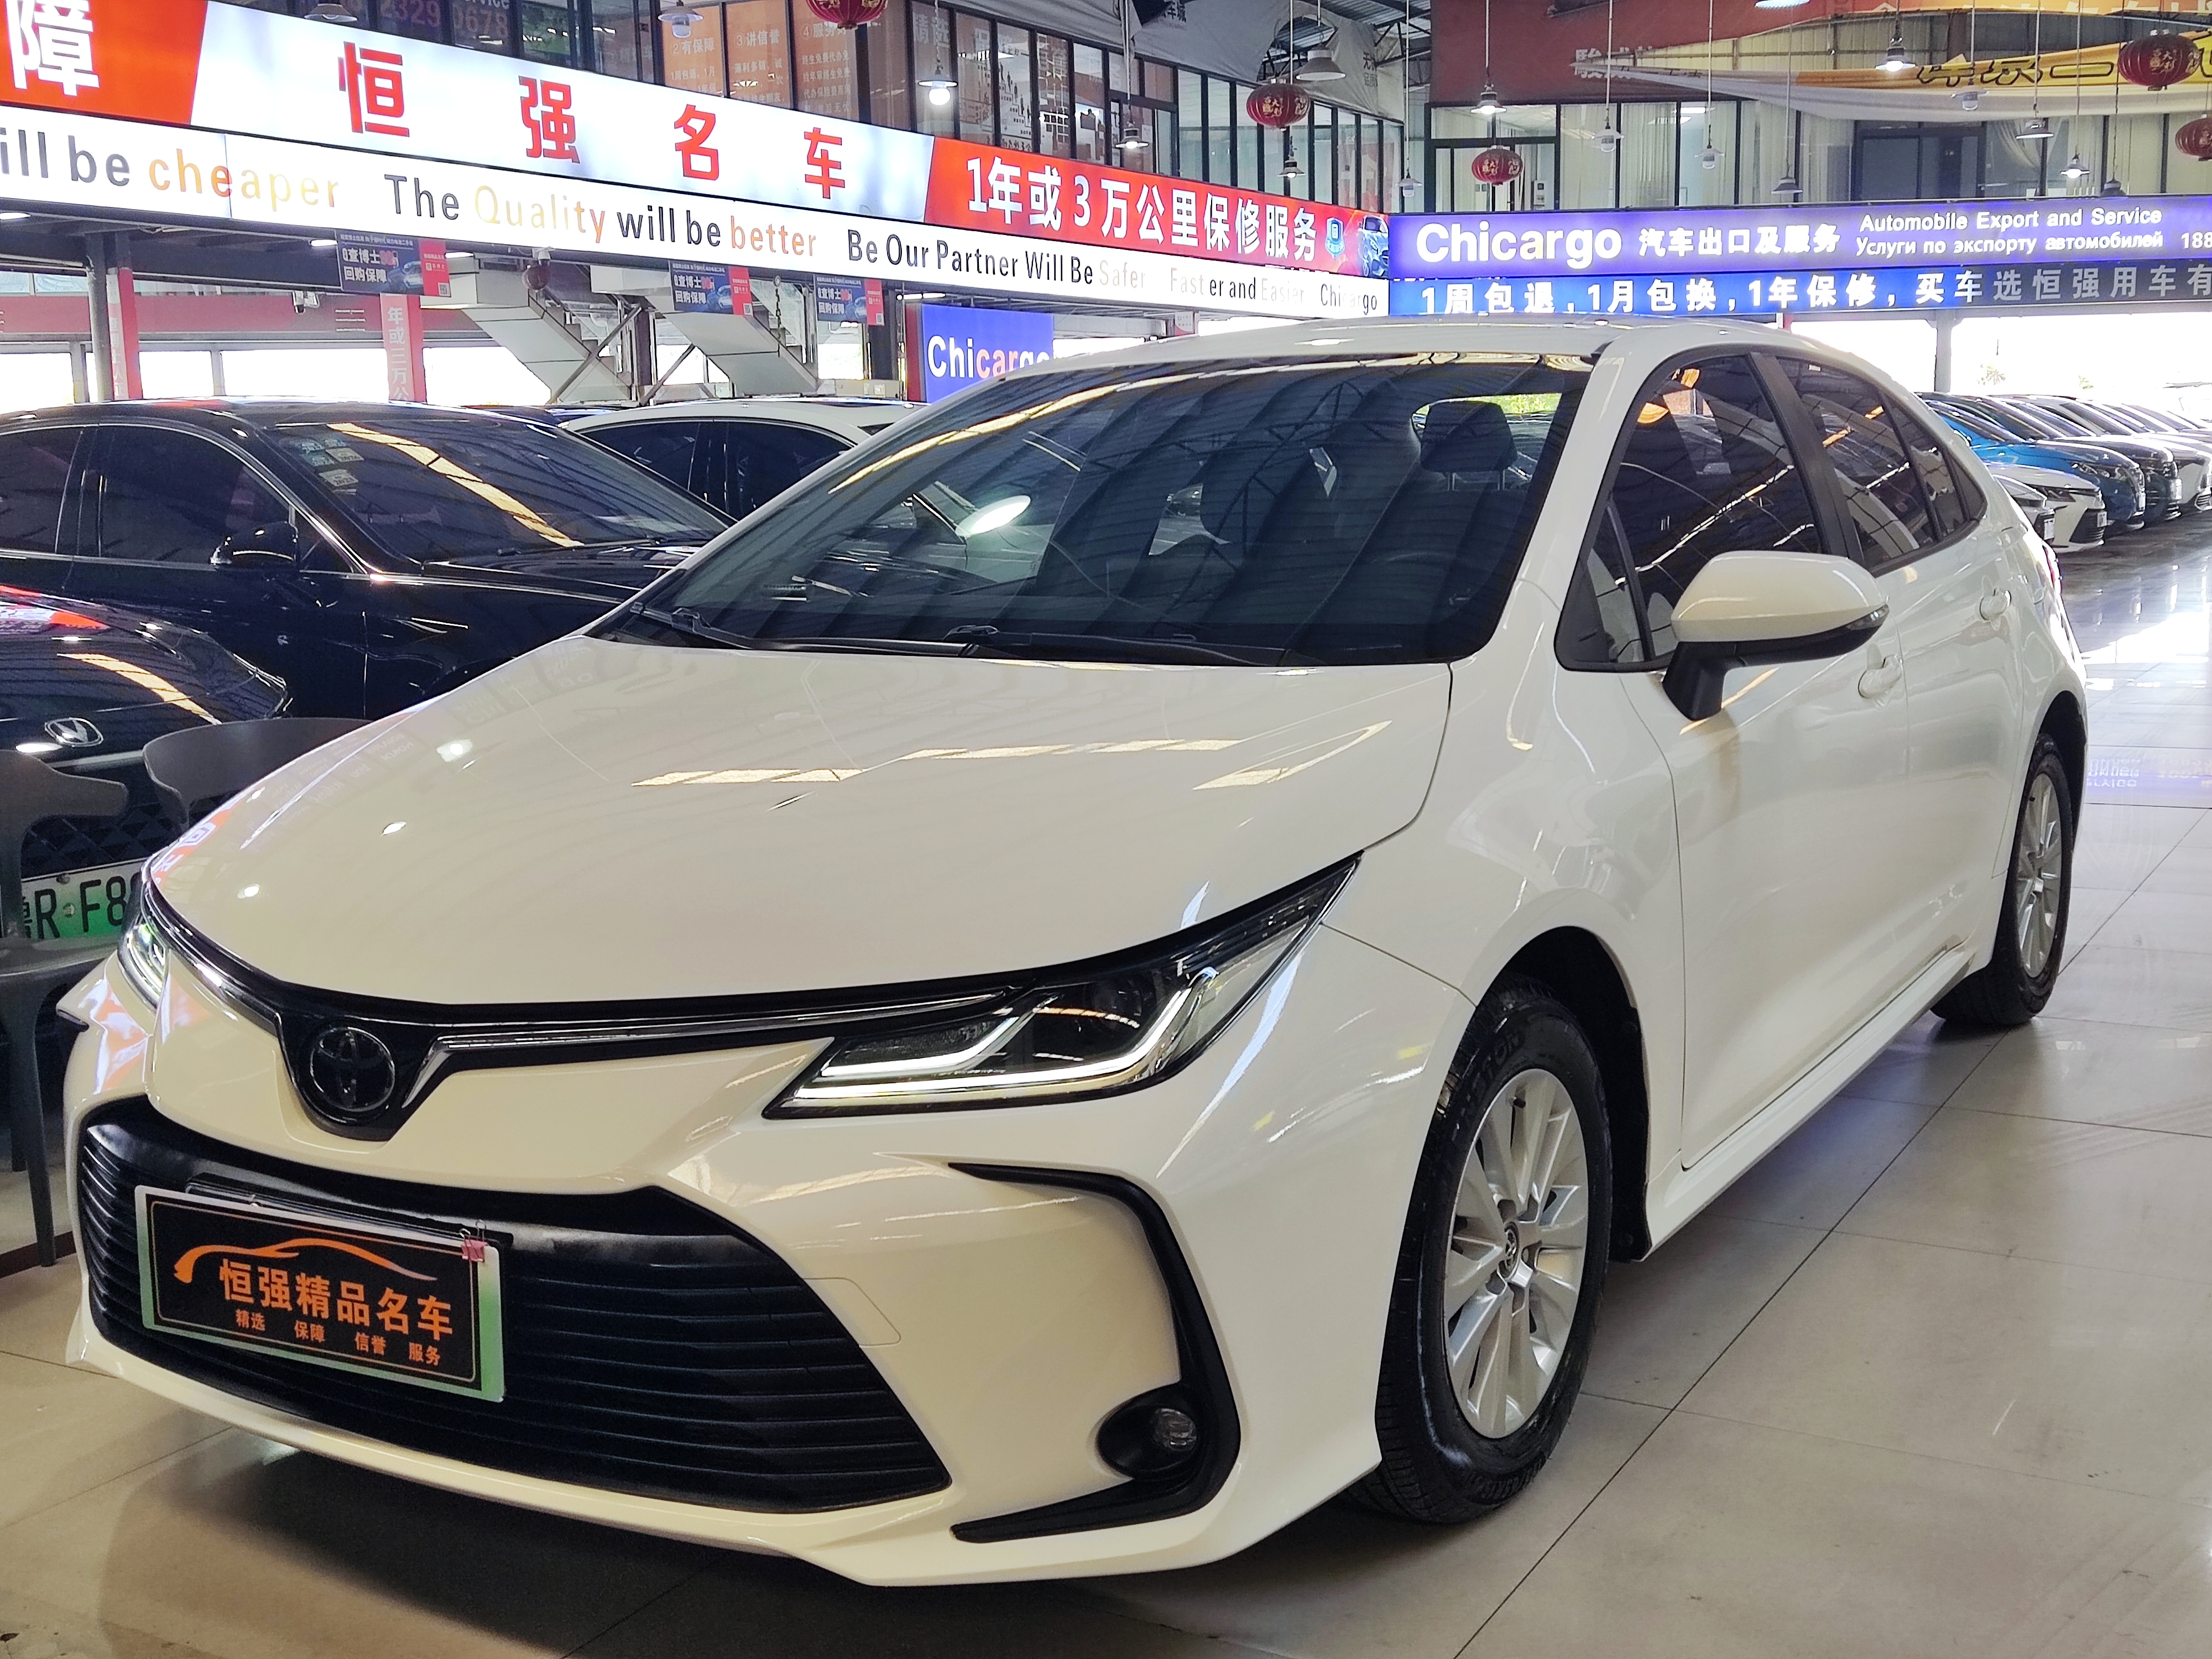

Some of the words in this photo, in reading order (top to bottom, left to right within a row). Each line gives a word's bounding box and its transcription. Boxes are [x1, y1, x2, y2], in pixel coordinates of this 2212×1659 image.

[67, 135, 131, 186] be
[149, 148, 339, 211] cheaper
[384, 174, 459, 220] The
[474, 185, 606, 243] Quality
[617, 205, 675, 242] will
[686, 210, 721, 247] be
[731, 216, 817, 257] better
[848, 228, 878, 263] Be
[886, 234, 928, 268] Our
[937, 239, 1019, 276] Partner
[1025, 251, 1064, 283] Will
[1071, 257, 1093, 285] Be
[1099, 260, 1146, 289] Safer
[1229, 277, 1256, 300] and
[1320, 283, 1378, 314] Chicargo
[967, 156, 1317, 262] 1年或3万公里保修服务
[1860, 211, 1968, 232] Automobile
[1976, 211, 2039, 230] Export
[2047, 209, 2083, 227] and
[2091, 207, 2162, 226] Service
[1416, 220, 1623, 269] Chicargo
[1639, 223, 1840, 257] 汽车出口及服务
[1856, 237, 1916, 259] Услуги
[1923, 241, 1946, 254] по
[1954, 237, 2037, 255] экспорту
[2046, 231, 2163, 251] автомобилей
[2181, 232, 2212, 249] 188
[219, 1258, 453, 1340] 恒强精品名车
[235, 1308, 265, 1332] 精选
[294, 1319, 326, 1343] 保障
[354, 1331, 387, 1356] 信誉
[408, 1342, 441, 1366] 服务
